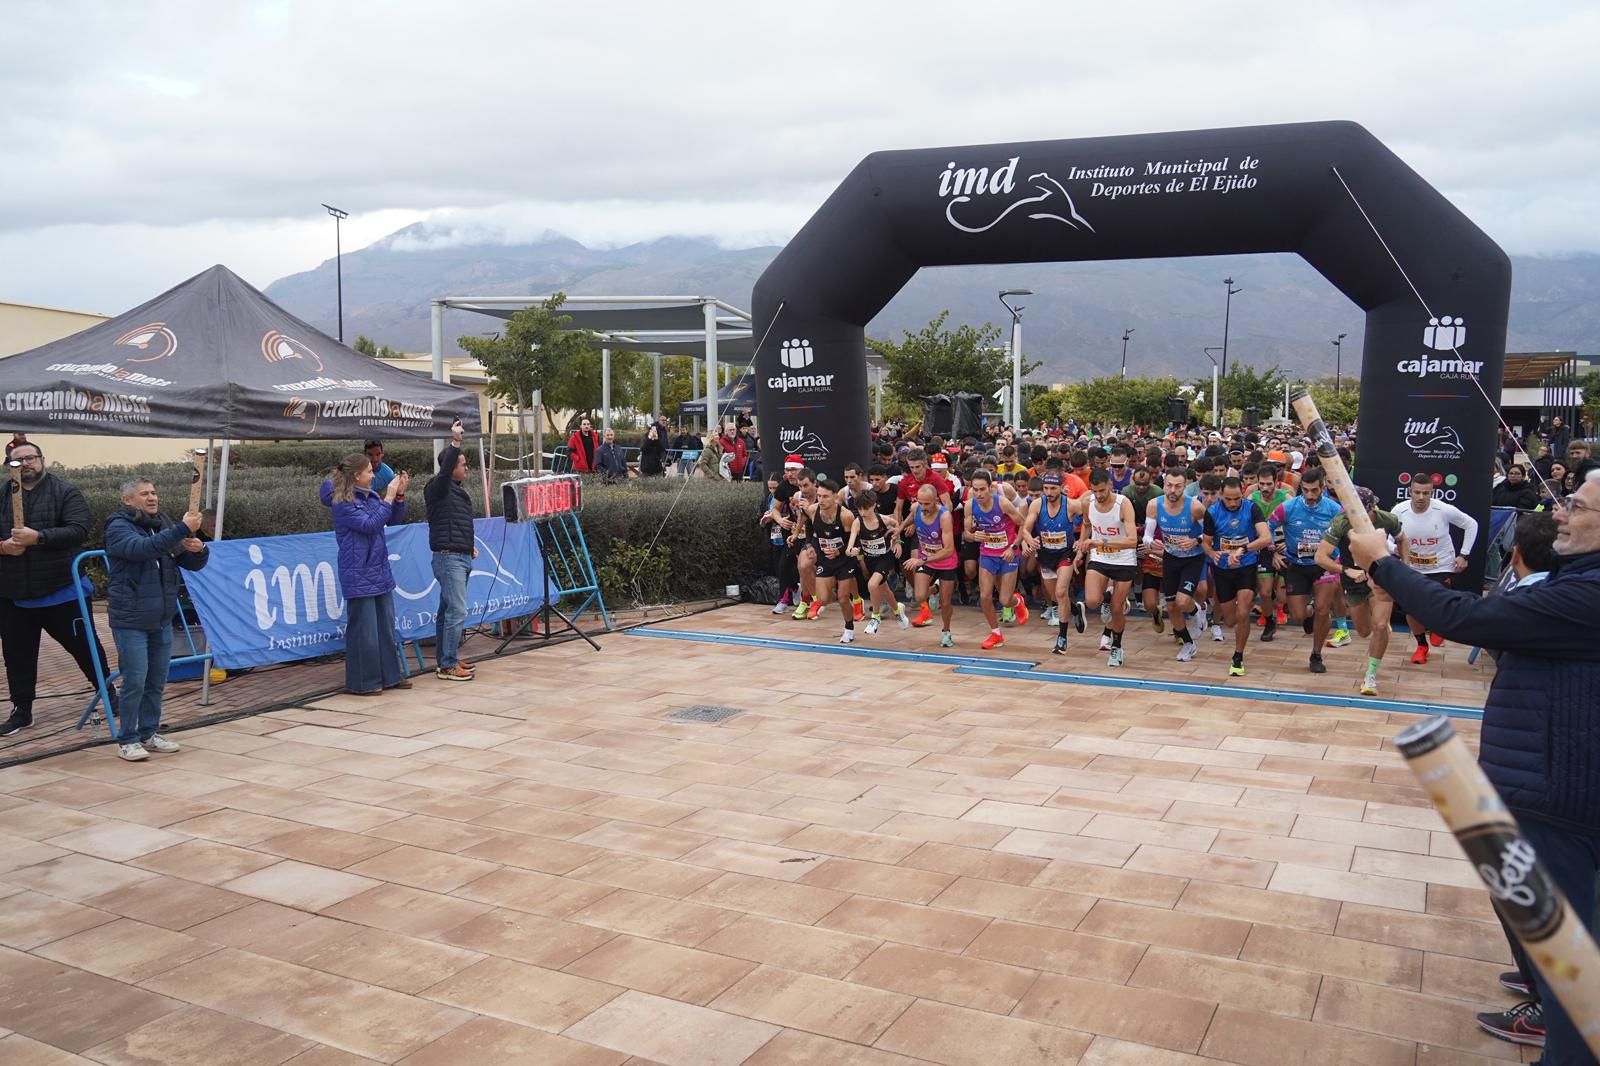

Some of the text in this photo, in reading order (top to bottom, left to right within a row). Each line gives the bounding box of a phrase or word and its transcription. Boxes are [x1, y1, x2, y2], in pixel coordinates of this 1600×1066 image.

[938, 156, 1020, 197] imd
[1067, 155, 1259, 180] Instituto Municipal de
[1090, 174, 1258, 200] Deportes de El Ejido
[1396, 354, 1485, 378] cajamar
[767, 372, 834, 393] cajamar
[779, 425, 805, 441] imd
[1403, 417, 1440, 434] imd
[1396, 487, 1411, 499] EL
[1411, 537, 1439, 546] ALSI
[245, 544, 346, 630] im
[471, 601, 485, 616] de
[487, 598, 500, 613] El
[400, 617, 413, 631] de
[268, 630, 331, 651] Instituto
